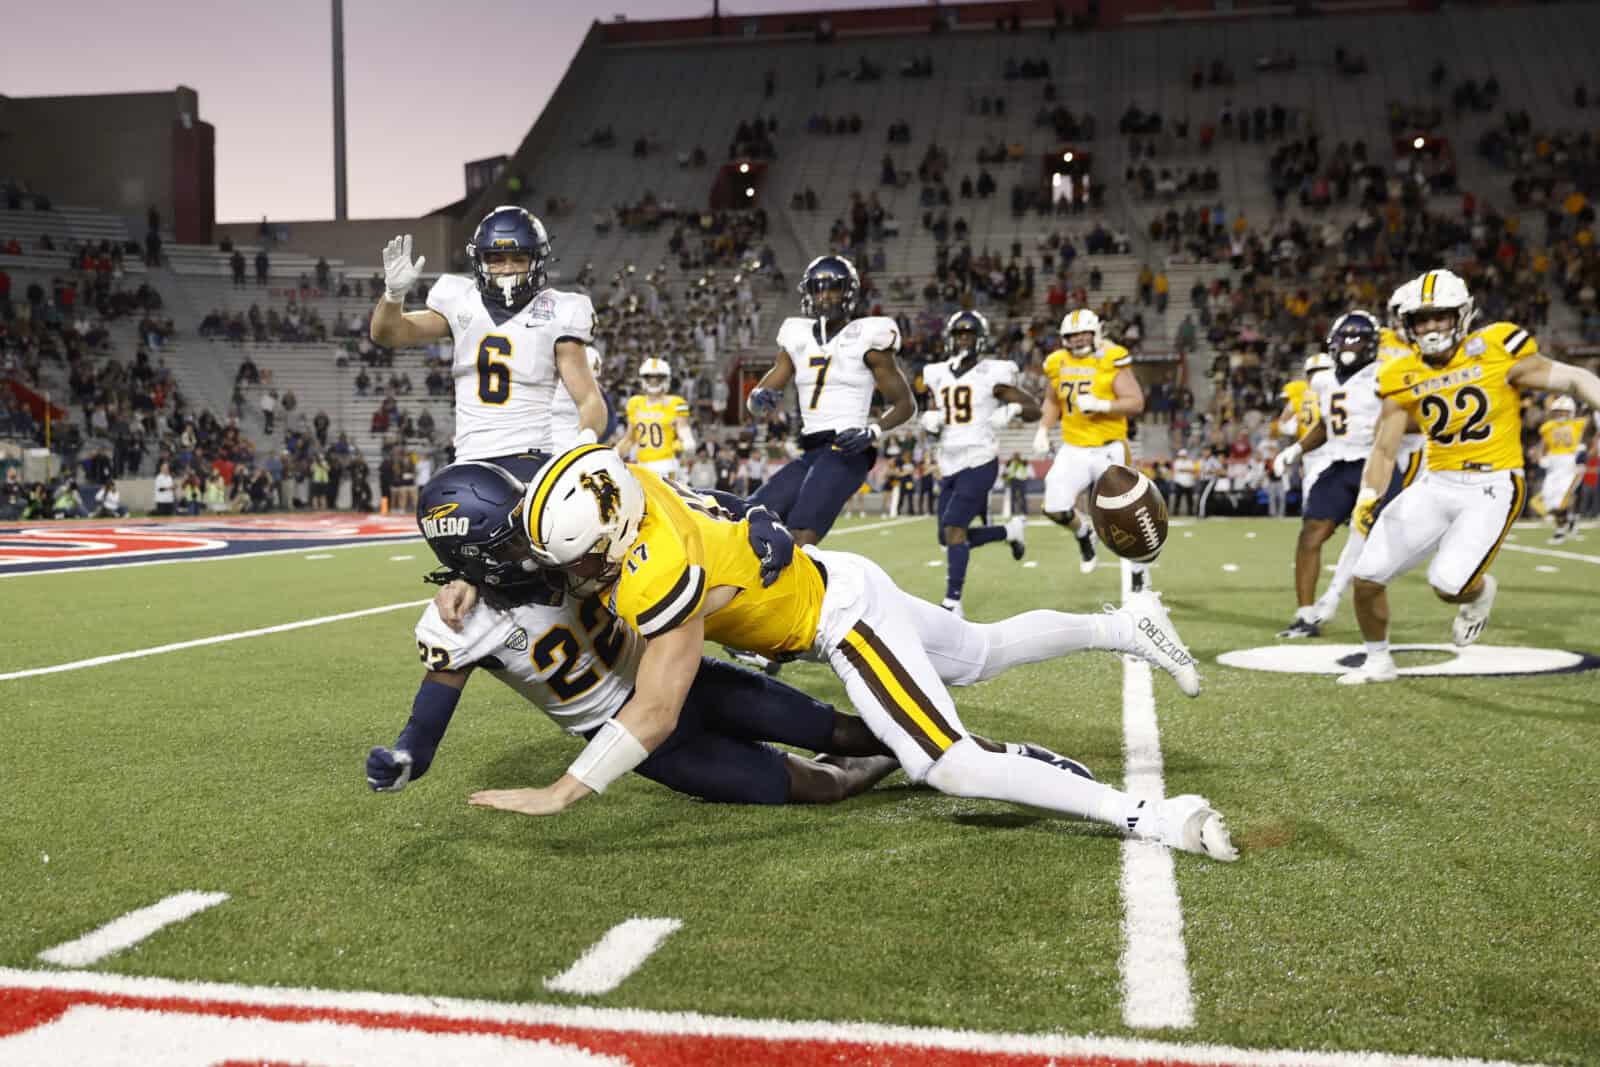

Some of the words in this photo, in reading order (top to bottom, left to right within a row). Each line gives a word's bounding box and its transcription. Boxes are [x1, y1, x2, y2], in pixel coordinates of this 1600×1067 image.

[476, 333, 514, 408] 6
[808, 354, 832, 411] 7
[1413, 364, 1484, 396] WYOMING
[939, 385, 973, 425] 19
[1330, 391, 1349, 437] 5
[1420, 384, 1492, 446] 22
[635, 421, 664, 448] 20
[421, 516, 470, 540] TOLEDO
[626, 543, 649, 574] 17
[417, 640, 450, 671] 22
[531, 597, 628, 704] 22
